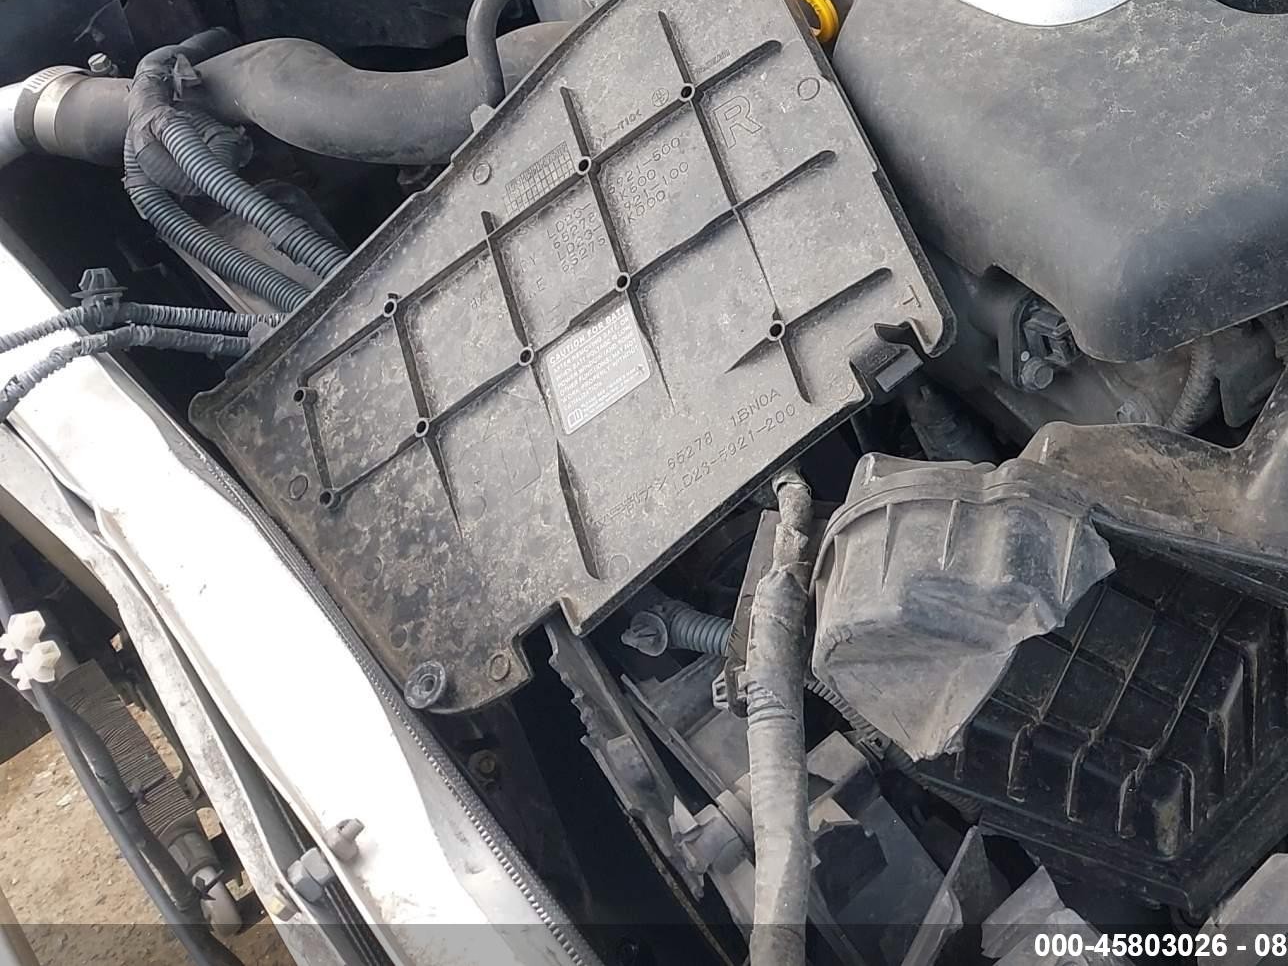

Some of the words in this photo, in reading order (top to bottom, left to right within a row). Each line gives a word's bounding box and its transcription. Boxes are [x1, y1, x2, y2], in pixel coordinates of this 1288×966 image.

[713, 96, 763, 150] R
[549, 334, 585, 365] CAUTION
[587, 321, 604, 338] FOR
